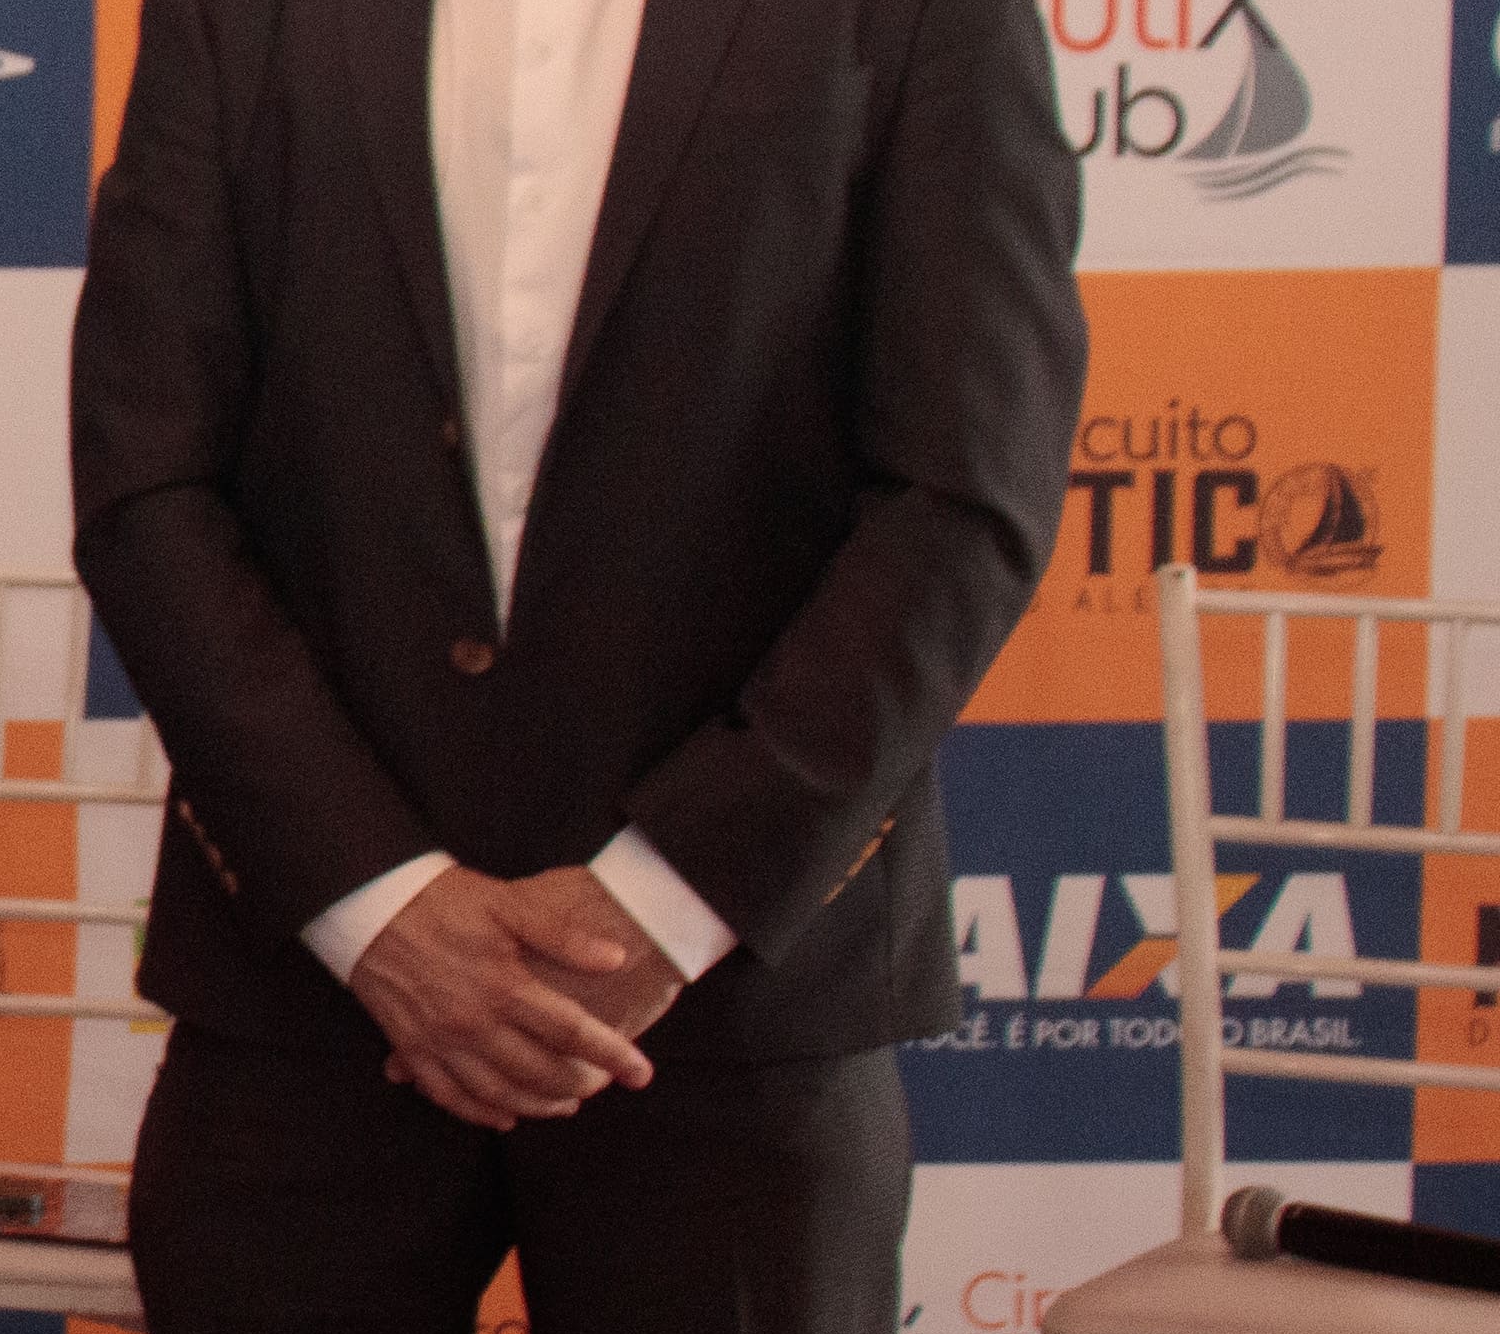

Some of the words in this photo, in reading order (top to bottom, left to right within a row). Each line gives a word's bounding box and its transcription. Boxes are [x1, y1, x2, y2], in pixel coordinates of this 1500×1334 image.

[1081, 399, 1257, 462] cuito
[950, 872, 1364, 1001] AIXA
[1032, 1019, 1100, 1050] POR
